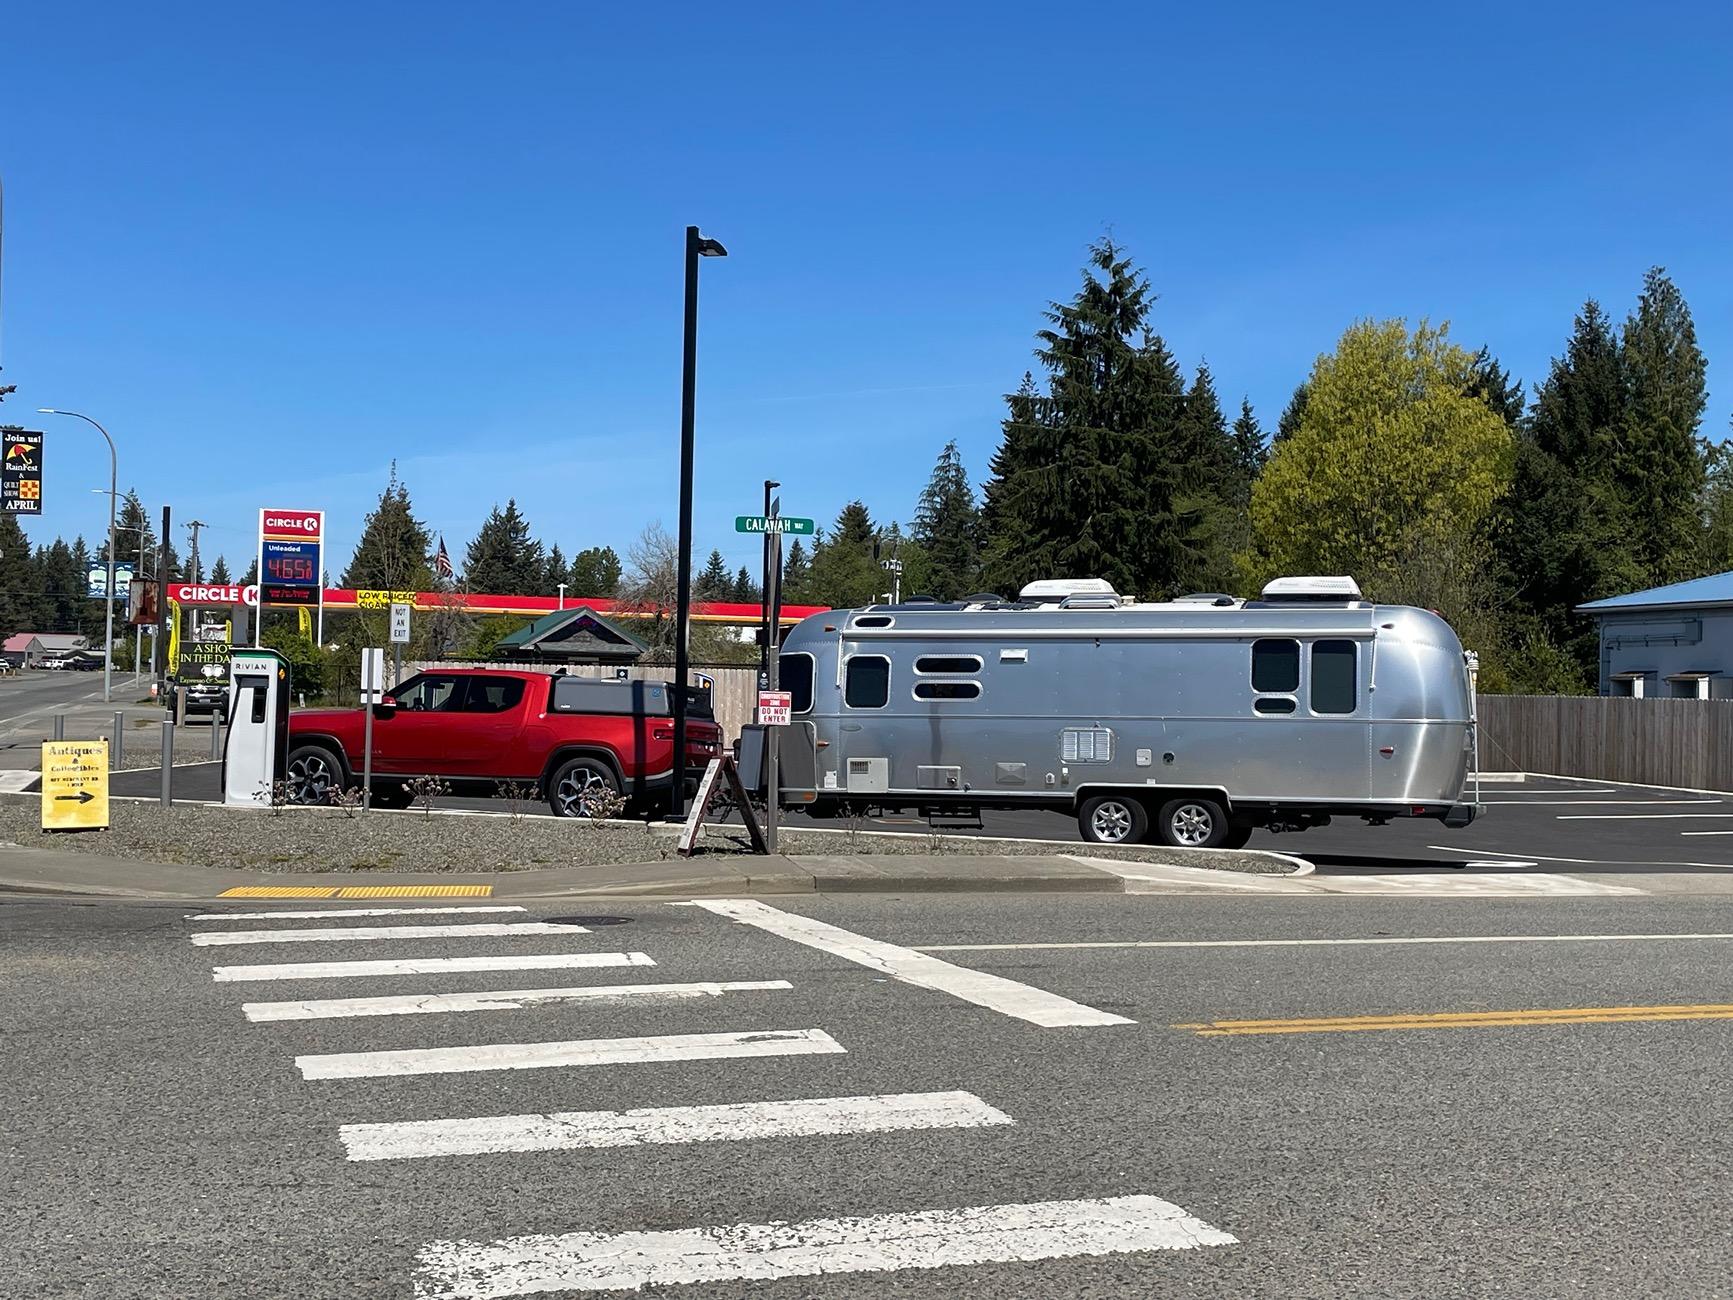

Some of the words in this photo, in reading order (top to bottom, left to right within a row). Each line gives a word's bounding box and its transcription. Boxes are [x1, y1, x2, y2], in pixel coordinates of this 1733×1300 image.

[5, 434, 25, 442] Join
[6, 463, 38, 471] RainFest
[5, 500, 38, 510] APRIL
[266, 518, 303, 528] CIRCLE
[304, 518, 317, 531] K
[746, 518, 791, 531] CALAWAH
[794, 522, 804, 530] WAY
[179, 586, 239, 601] CIRCLE
[395, 608, 406, 616] NOT
[394, 629, 406, 637] EXIT
[194, 644, 203, 653] A
[180, 653, 192, 662] IN
[193, 653, 213, 662] THE
[761, 707, 771, 715] DO
[49, 747, 102, 757] Antiques
